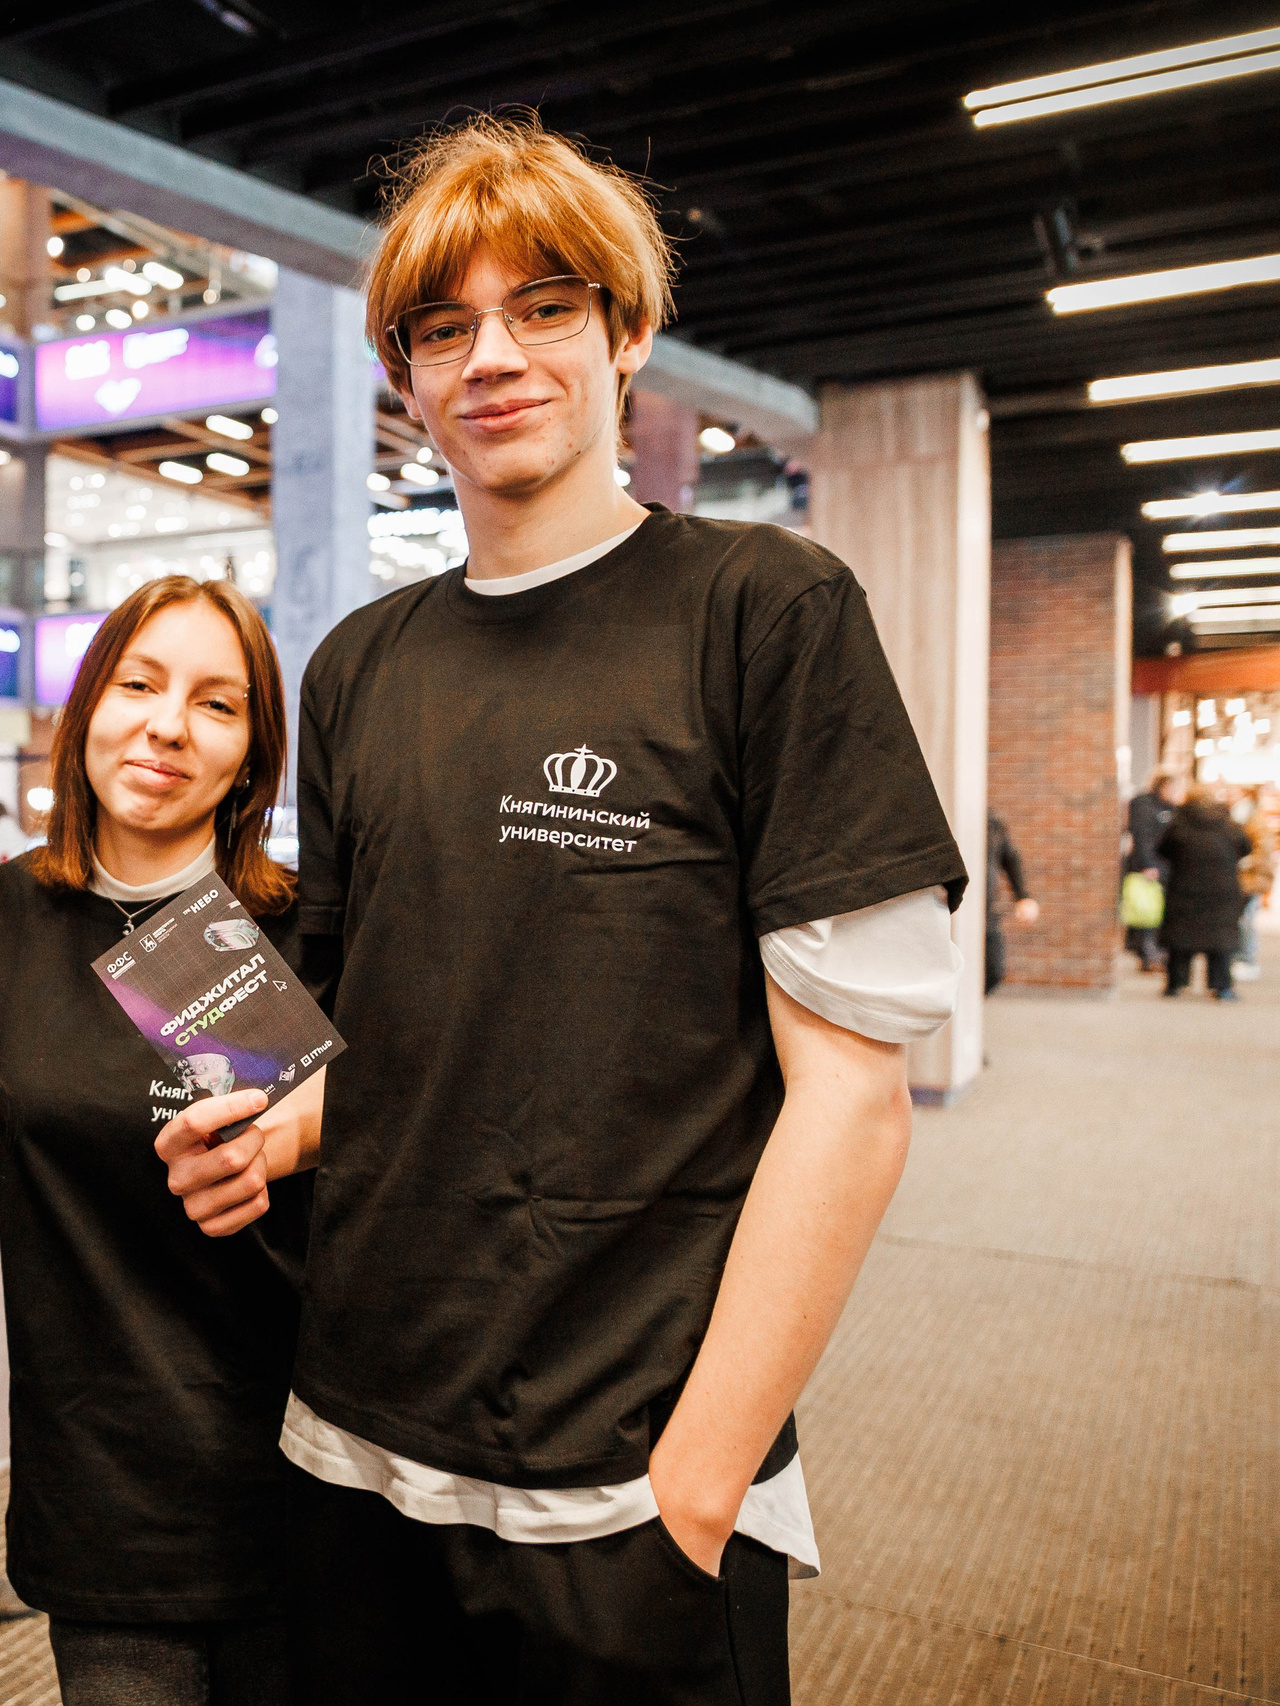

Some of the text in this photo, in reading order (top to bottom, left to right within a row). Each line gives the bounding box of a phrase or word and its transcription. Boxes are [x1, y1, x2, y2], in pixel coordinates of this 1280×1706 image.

[499, 794, 651, 830] Княгининский
[498, 825, 638, 853] университет
[189, 889, 219, 914] НЕБО
[106, 951, 133, 974] ФФС
[160, 953, 266, 1037] ФИДЖИТАЛ
[175, 969, 268, 1046] СТУДФЕСТ
[309, 1039, 333, 1060] IThub
[149, 1080, 194, 1101] Княг
